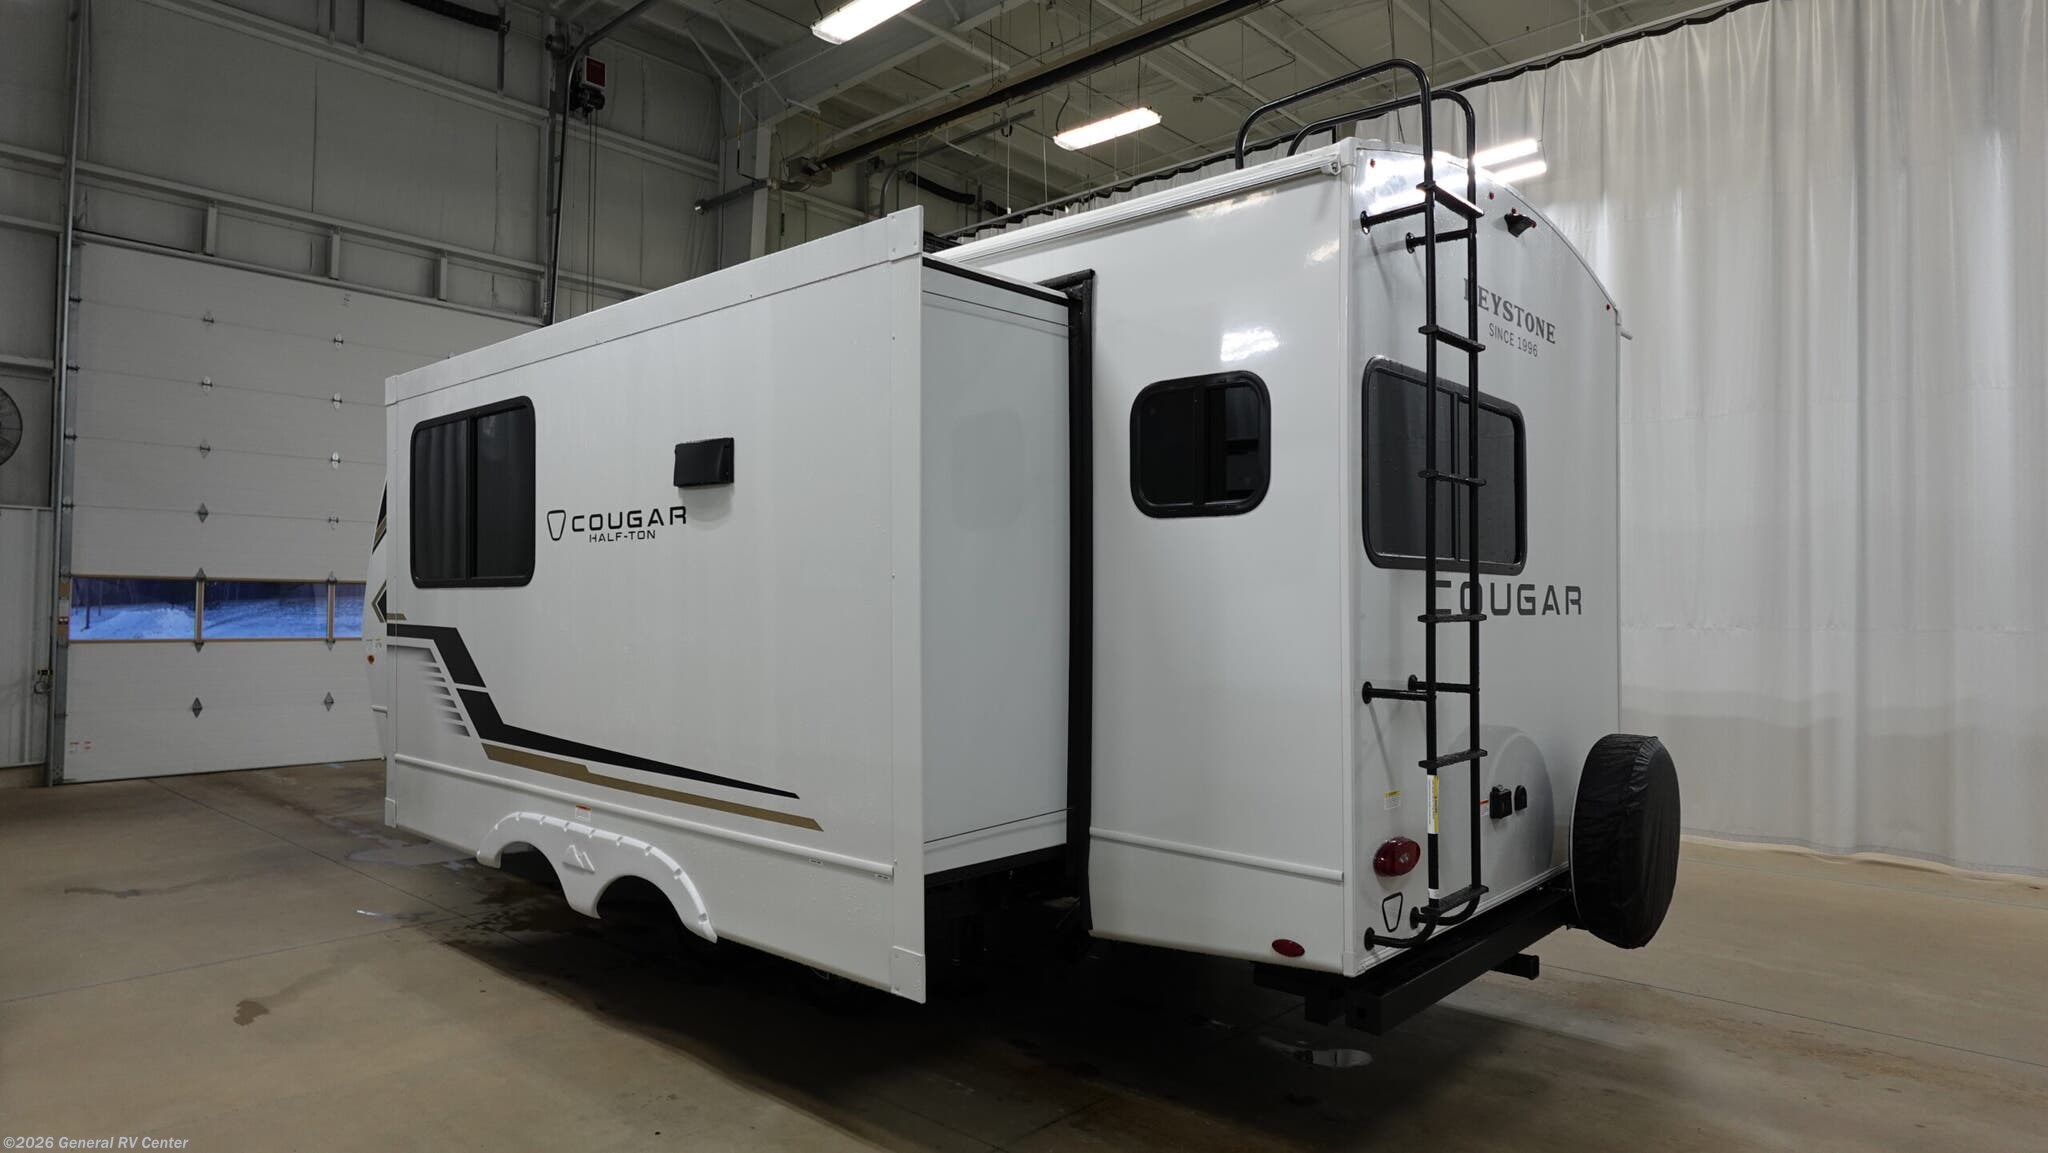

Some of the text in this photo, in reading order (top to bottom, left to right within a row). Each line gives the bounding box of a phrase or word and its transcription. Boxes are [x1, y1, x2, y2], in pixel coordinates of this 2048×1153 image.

[1488, 322, 1538, 358] SINCE 1996
[571, 505, 687, 533] COUGAR
[589, 529, 656, 543] HALF-TON
